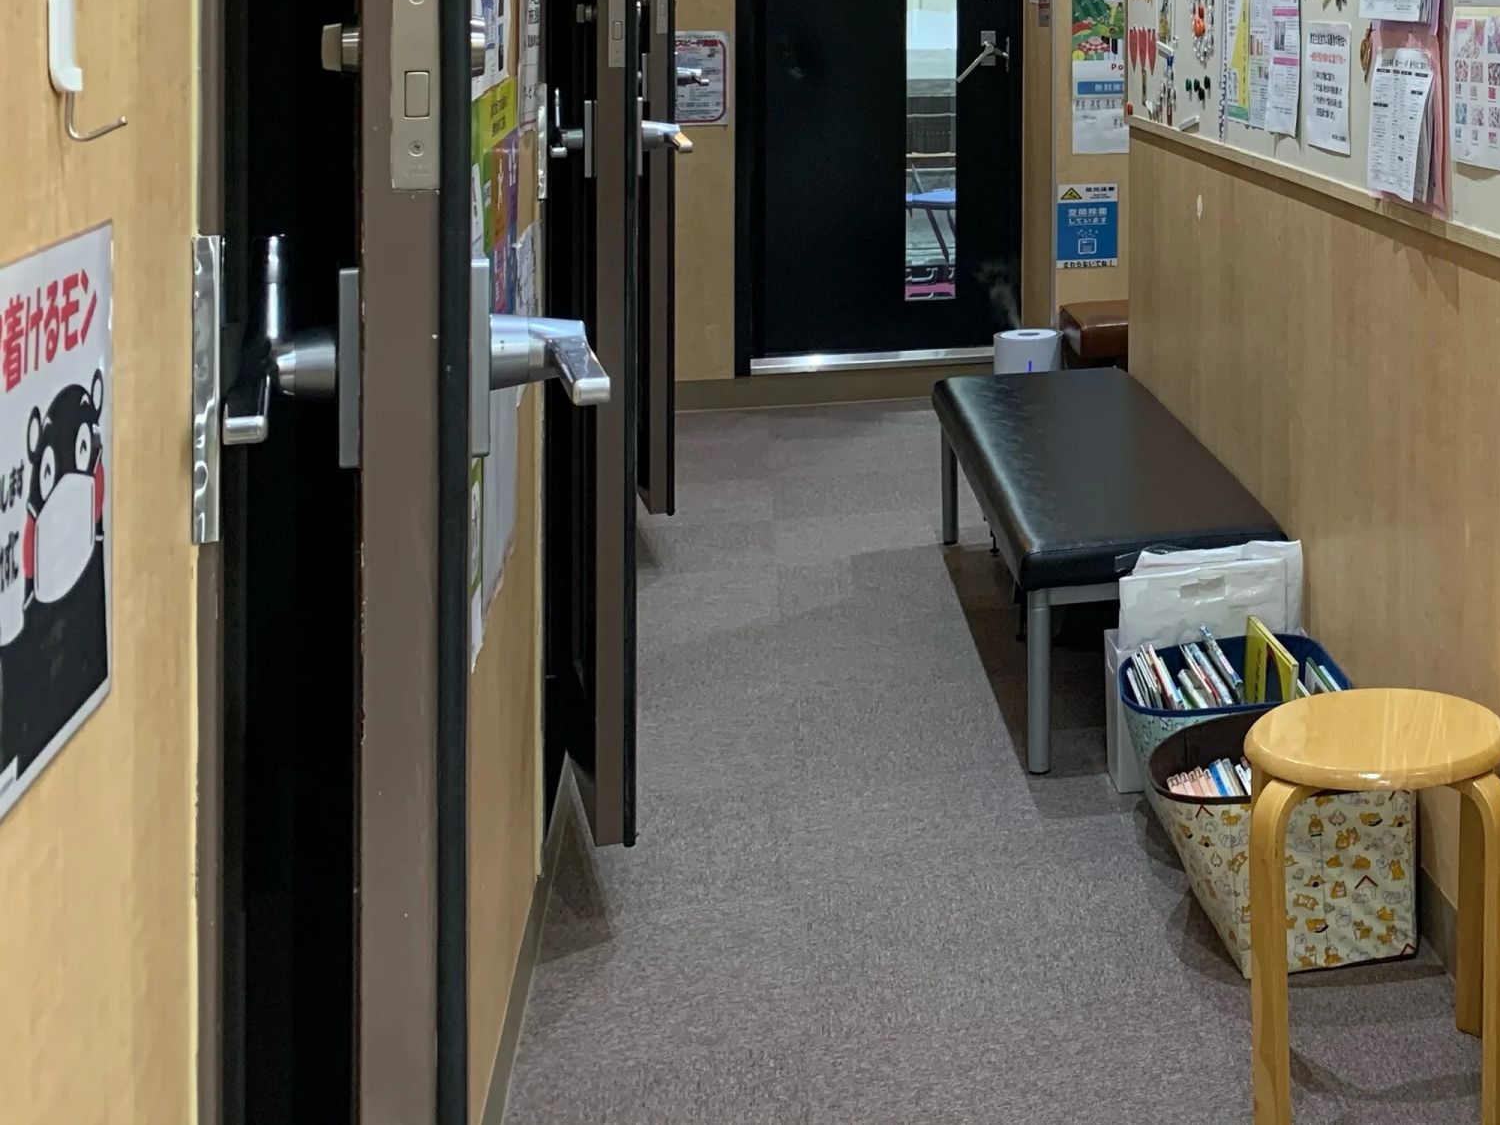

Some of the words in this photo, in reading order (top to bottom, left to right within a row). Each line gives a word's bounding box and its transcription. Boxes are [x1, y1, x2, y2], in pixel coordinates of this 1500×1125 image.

[1094, 83, 1124, 92] 無料体
[1068, 217, 1107, 225] しています
[0, 268, 98, 393] 着けるモン
